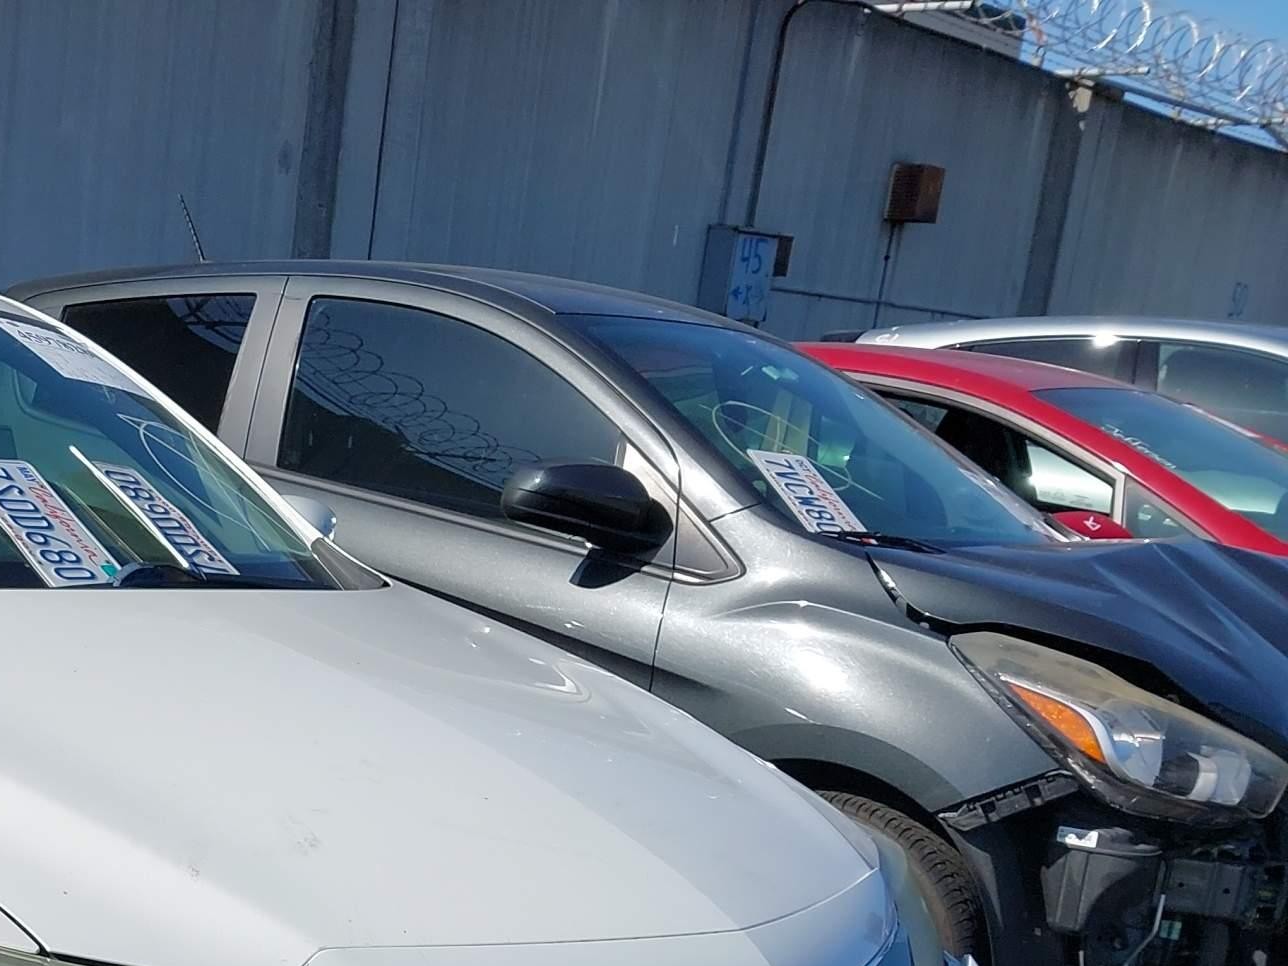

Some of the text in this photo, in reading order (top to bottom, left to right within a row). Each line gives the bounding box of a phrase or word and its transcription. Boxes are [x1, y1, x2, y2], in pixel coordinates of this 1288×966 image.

[740, 236, 769, 274] 45
[16, 465, 39, 484] MAY
[28, 484, 100, 567] California
